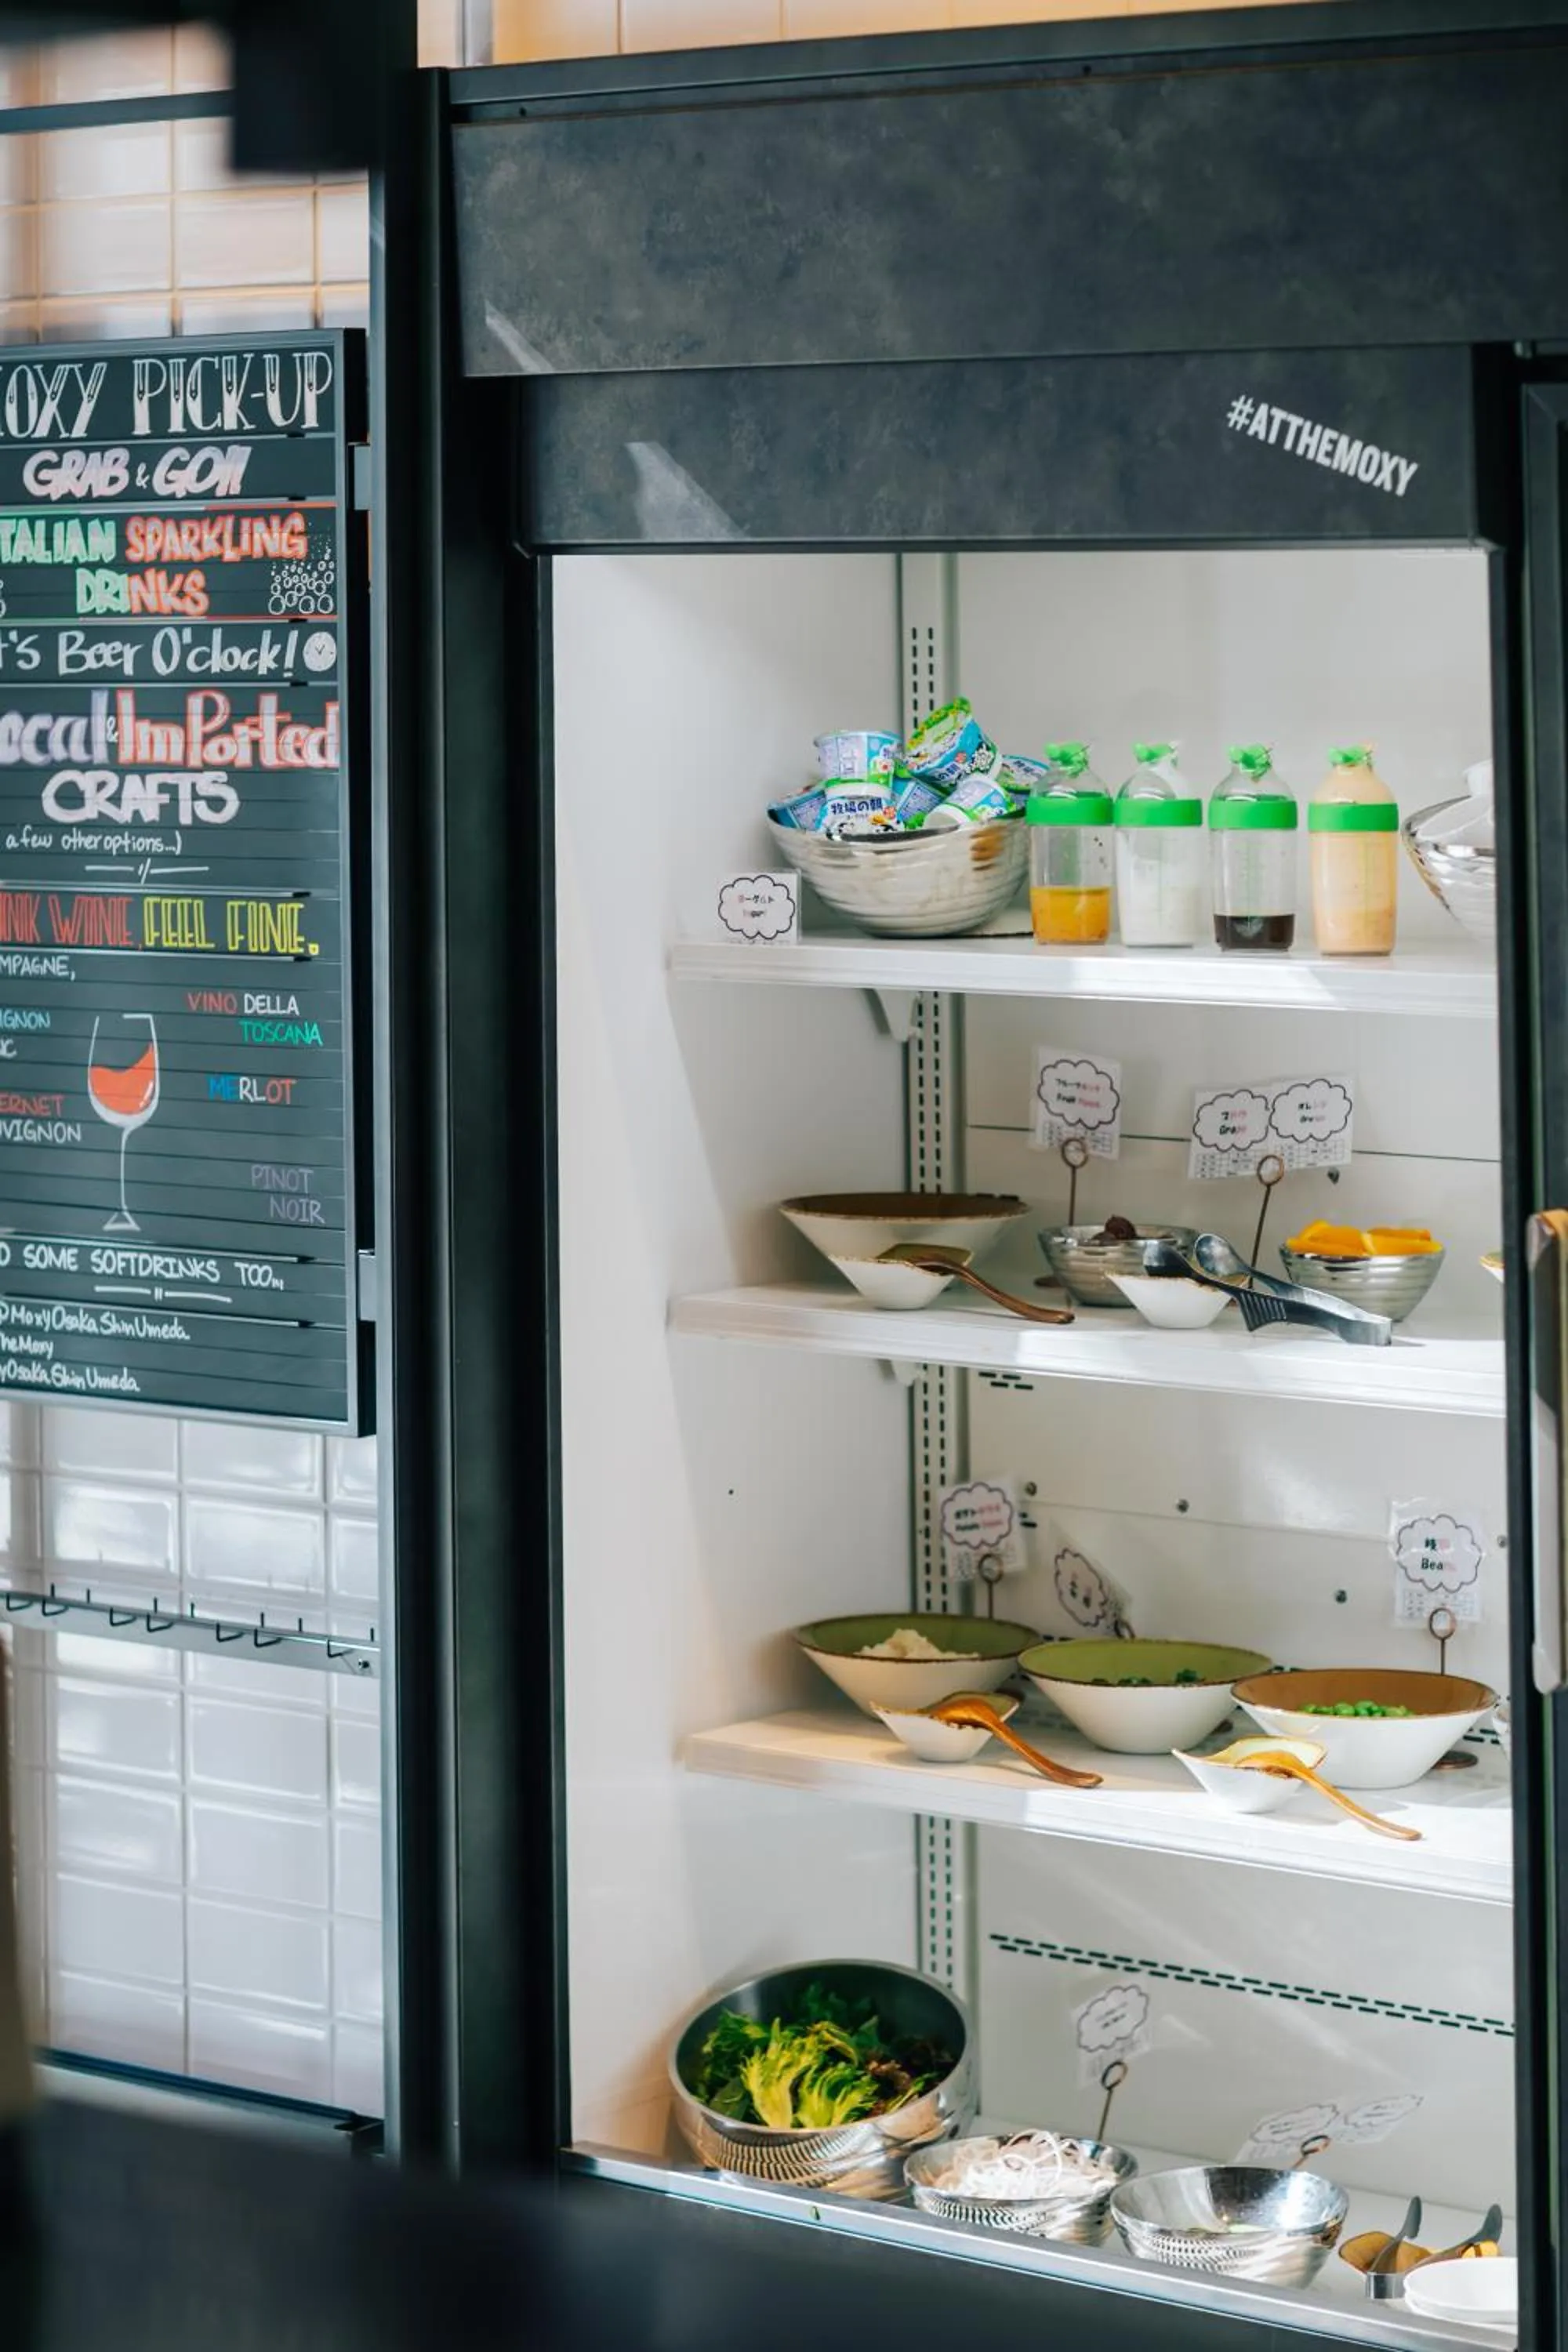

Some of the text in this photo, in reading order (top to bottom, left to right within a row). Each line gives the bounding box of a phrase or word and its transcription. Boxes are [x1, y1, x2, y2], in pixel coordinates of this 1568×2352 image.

[0, 351, 334, 438] OXY PICK-UP
[1226, 394, 1418, 496] #ATTHEMOXY
[23, 448, 129, 500] GRAB
[136, 462, 150, 489] &
[125, 513, 308, 563] SPARKLING
[76, 568, 209, 615] DRINKS
[58, 630, 143, 677] Beer
[42, 769, 240, 825] CRAFTS
[20, 826, 53, 848] few
[143, 896, 215, 948] FEEL
[187, 992, 299, 1015] VINO DELLA
[239, 1019, 323, 1046] TOSCANA
[209, 1074, 297, 1105] MERLOT
[0, 1119, 82, 1144] VIGNON
[251, 1164, 313, 1193] PINOT
[270, 1195, 325, 1224] NOIR
[23, 1243, 78, 1271] SOME
[90, 1248, 220, 1283] SOFTDRINKS
